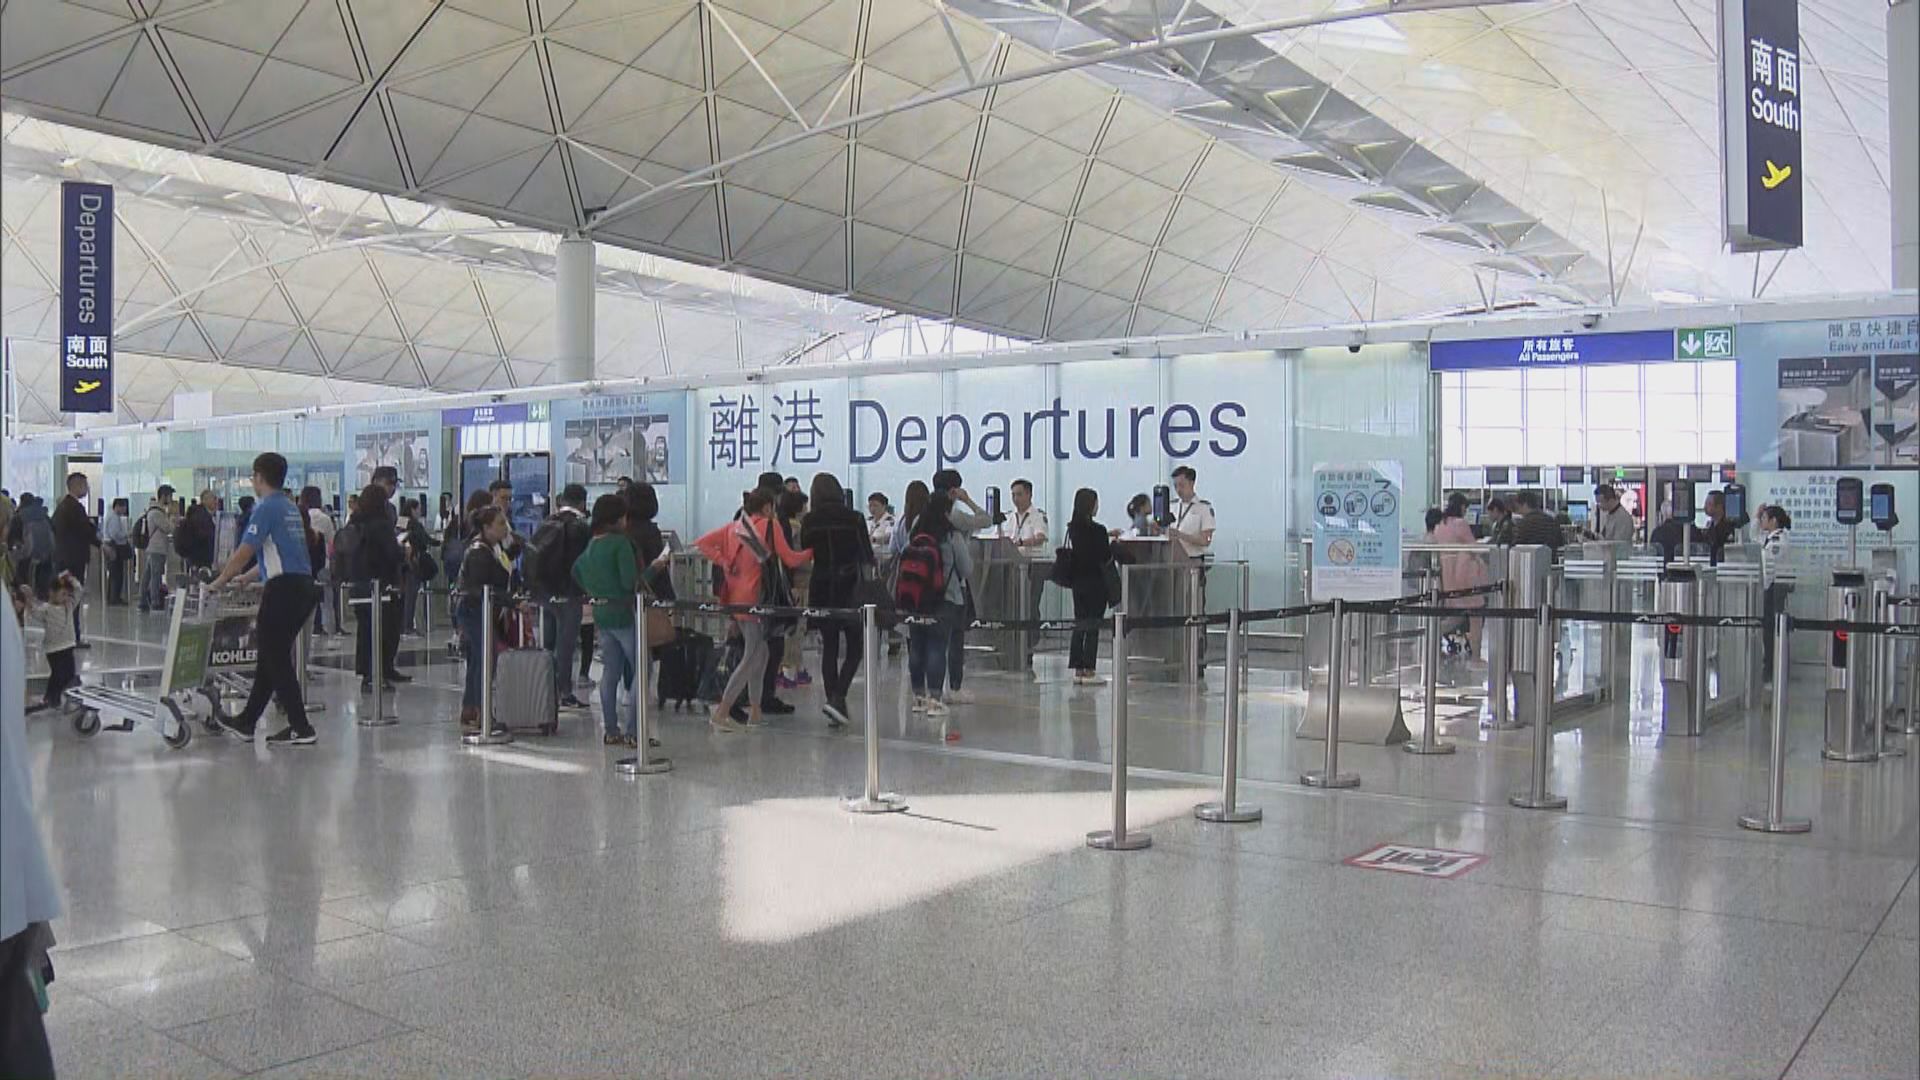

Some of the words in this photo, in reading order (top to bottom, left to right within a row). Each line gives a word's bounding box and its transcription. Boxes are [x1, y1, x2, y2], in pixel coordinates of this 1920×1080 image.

[1750, 38, 1797, 96] 南面
[1751, 88, 1799, 131] South
[74, 193, 102, 324] Departures
[66, 335, 108, 355] 南面
[1519, 351, 1531, 362] All
[1532, 351, 1580, 363] Passengers
[1522, 338, 1575, 353] 所有旅客
[1829, 340, 1858, 353] Easy
[1862, 339, 1885, 351] and
[1889, 338, 1912, 350] fast
[66, 354, 108, 369] South
[708, 388, 825, 471] 離港
[848, 397, 1249, 473] Departures
